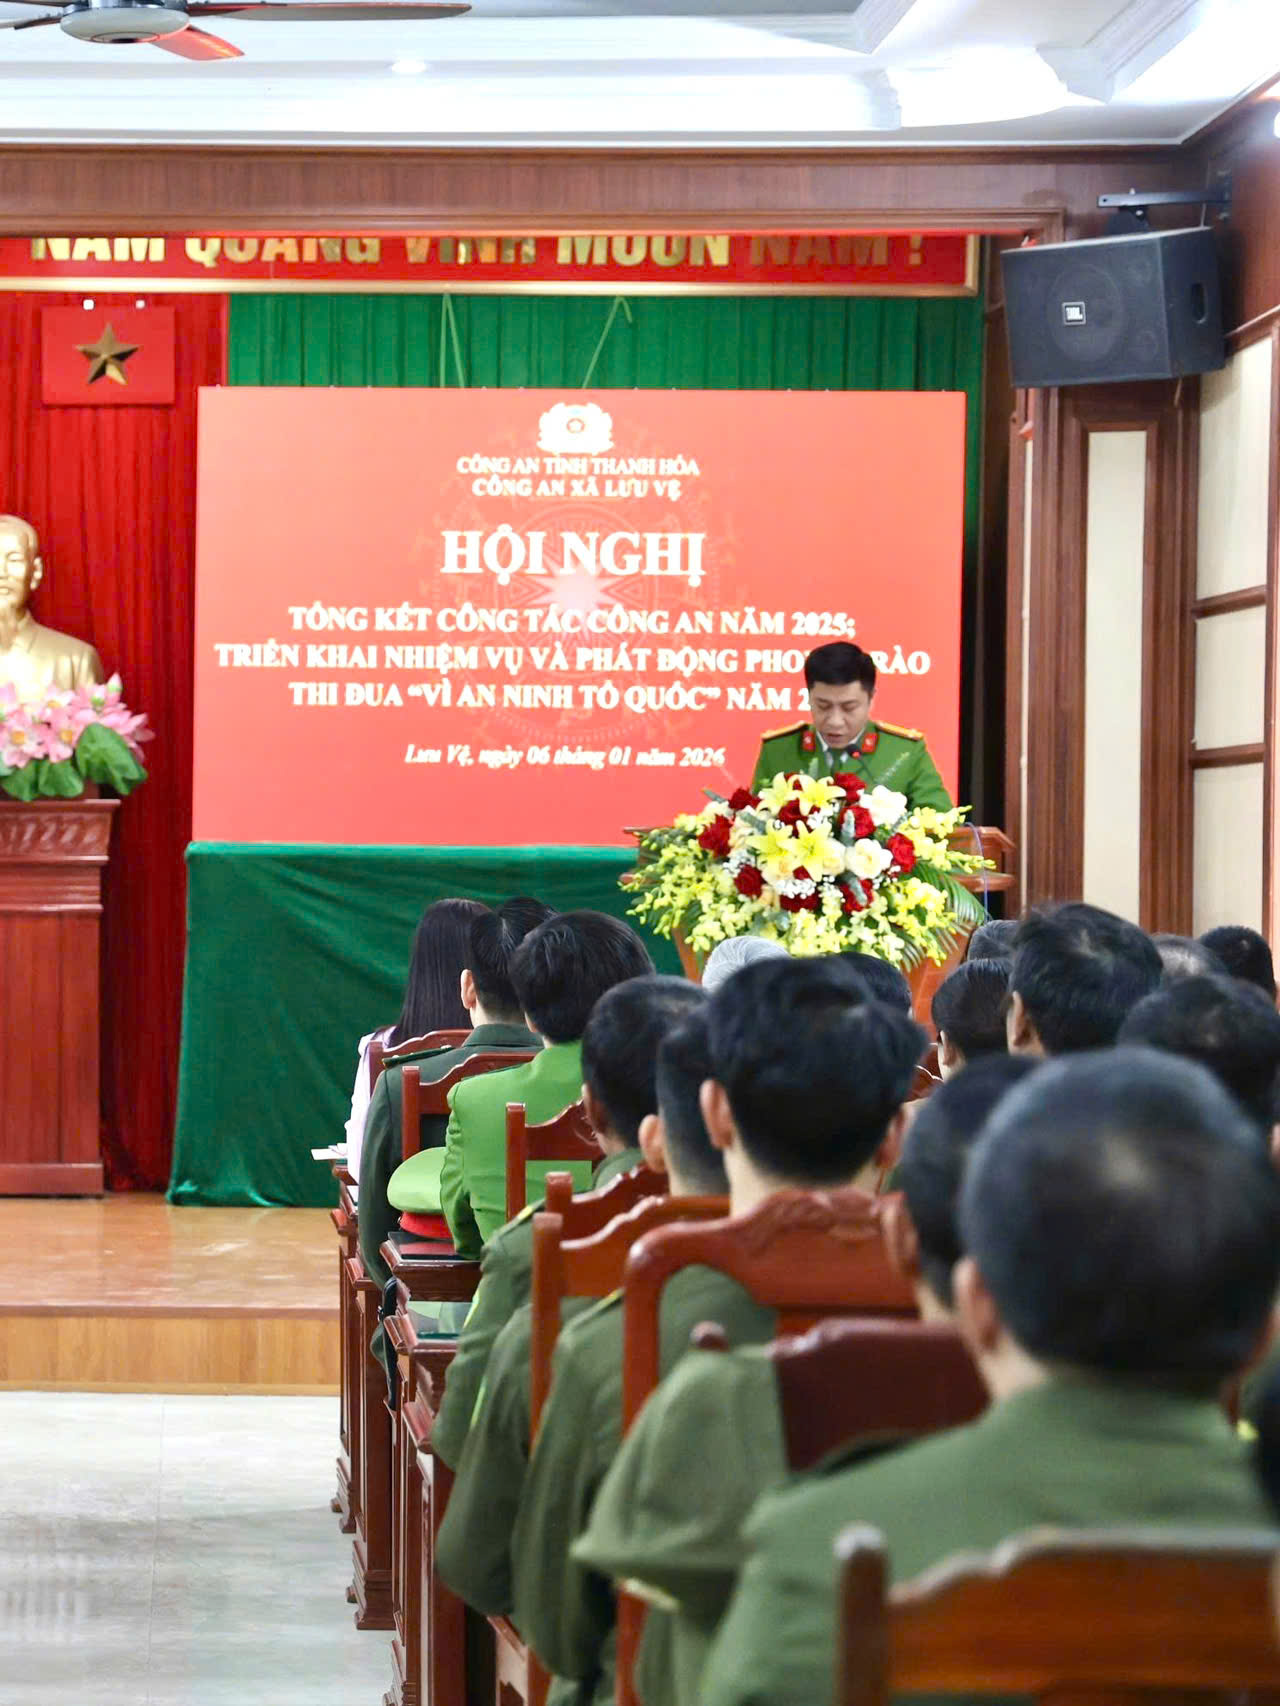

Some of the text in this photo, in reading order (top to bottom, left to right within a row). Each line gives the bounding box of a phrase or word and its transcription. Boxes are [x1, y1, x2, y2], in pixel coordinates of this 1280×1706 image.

[456, 453, 513, 474] CÔNG
[512, 457, 539, 474] AN
[591, 457, 656, 475] THANH
[659, 454, 700, 476] HÓA
[472, 474, 532, 496] CÔNG
[536, 479, 565, 496] AN
[570, 477, 599, 497] XÃ
[440, 524, 706, 588] HỘI NGHỊ
[375, 601, 432, 632] KẾT
[437, 602, 519, 633] CÔNG
[524, 604, 581, 634] TÁC
[587, 603, 669, 634] CÔNG
[674, 611, 713, 635] AN
[720, 606, 784, 635] NĂM
[307, 644, 377, 668] KHAI
[385, 642, 478, 675] NHIỆM
[484, 646, 523, 675] VỤ
[530, 641, 569, 672] VÀ
[576, 641, 652, 672] PHÁT
[658, 645, 738, 678] ĐỘNG
[745, 649, 810, 674] PHO
[872, 645, 931, 675] RÀO
[288, 682, 338, 706] THI
[345, 683, 403, 706] ĐUA
[456, 684, 496, 707] AN
[503, 685, 575, 709] NINH
[727, 683, 792, 711] NĂM
[527, 746, 550, 765] 06
[609, 747, 631, 766] 01
